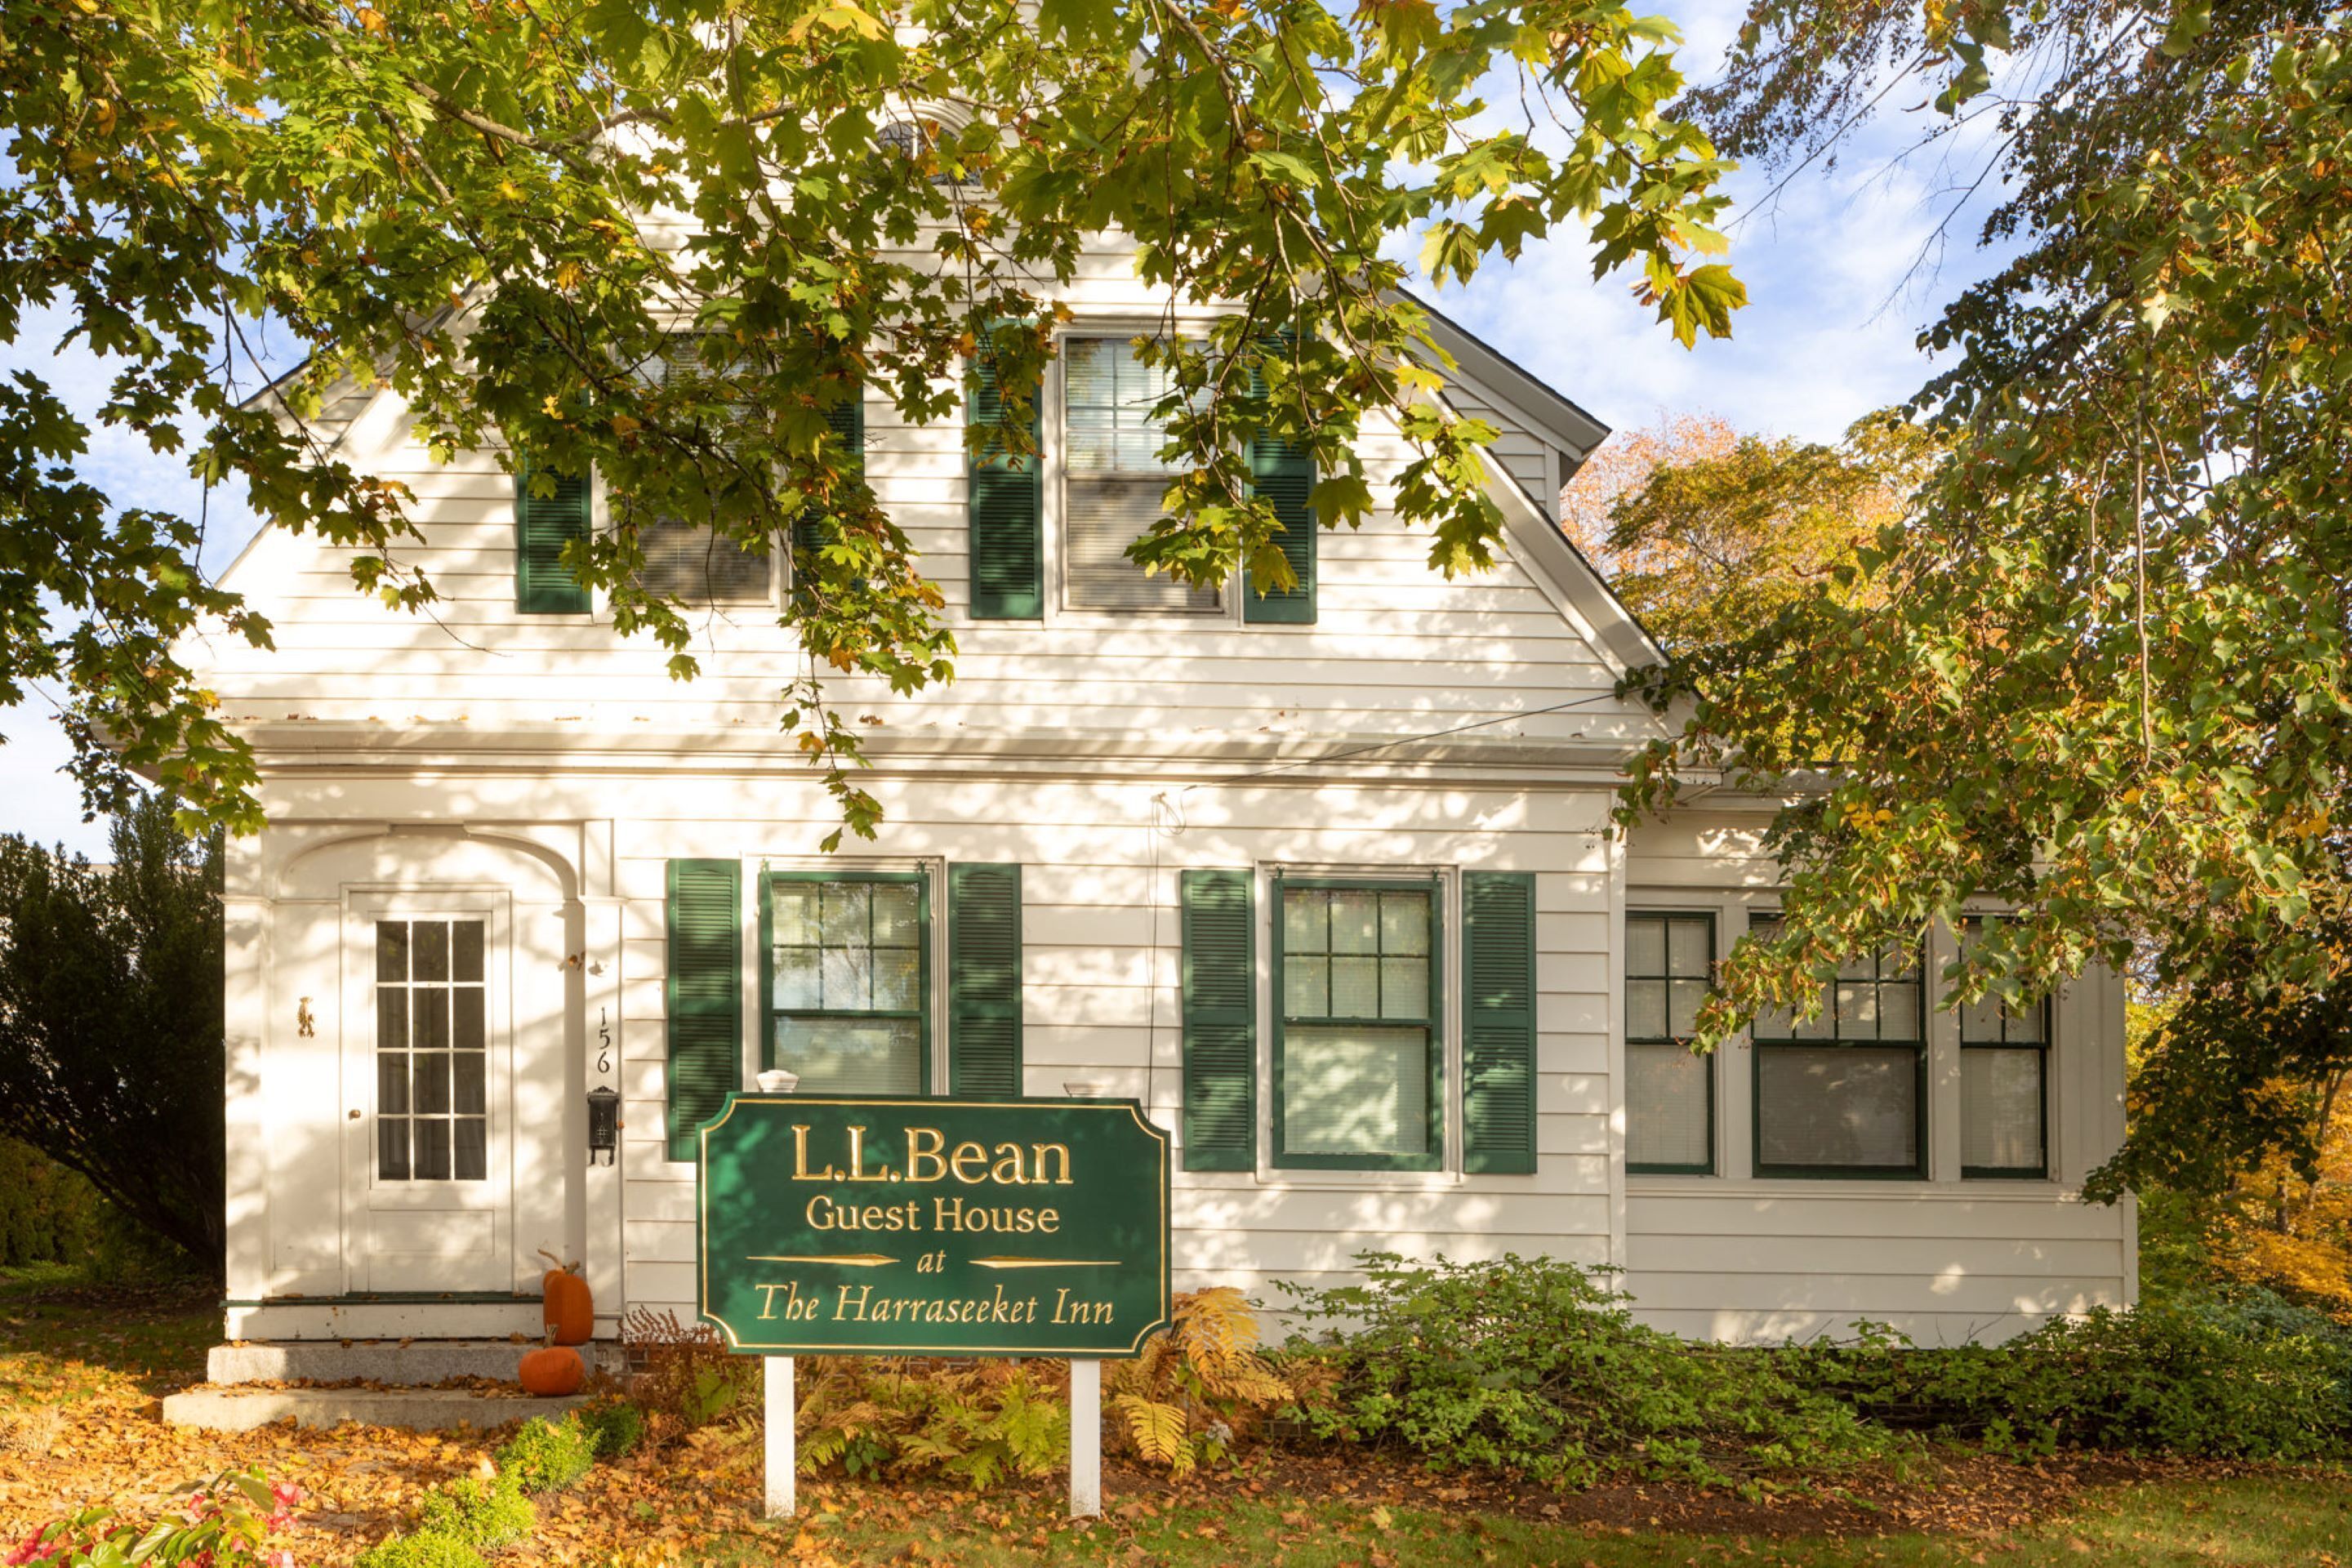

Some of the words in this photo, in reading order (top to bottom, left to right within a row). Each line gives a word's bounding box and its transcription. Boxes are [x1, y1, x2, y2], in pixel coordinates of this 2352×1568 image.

[597, 1007, 611, 1074] 156
[791, 1124, 1074, 1185] L.L.Bean
[805, 1195, 921, 1232] Guest
[933, 1196, 1060, 1234] House
[916, 1248, 946, 1274] at
[755, 1281, 818, 1321] The
[831, 1284, 1039, 1325] Harraseeket
[1049, 1287, 1115, 1325] Inn
